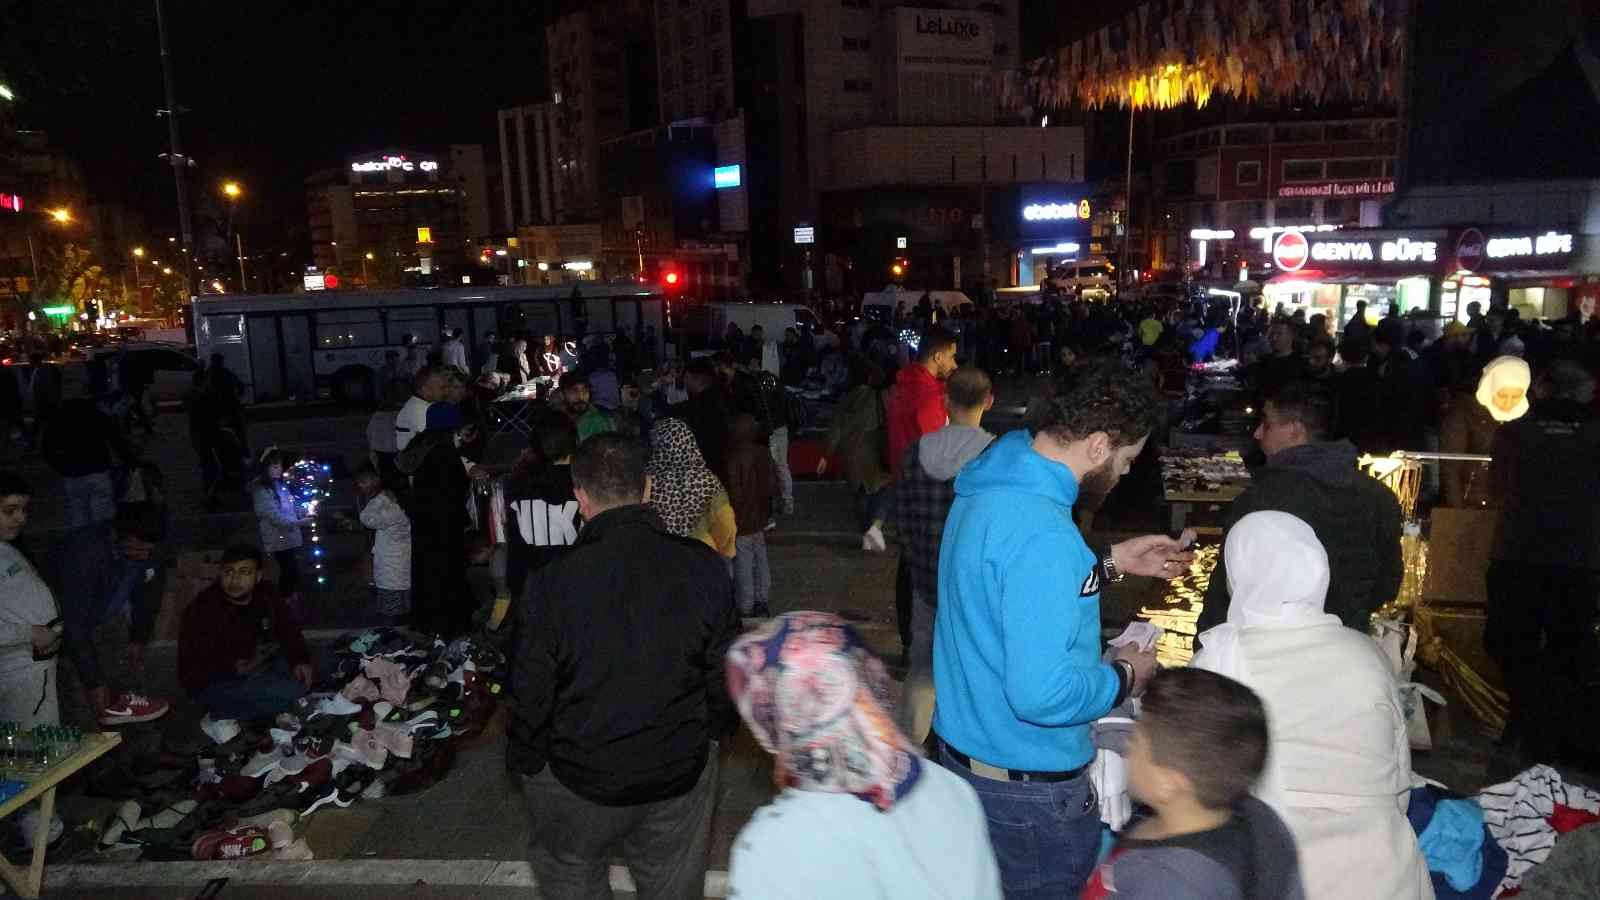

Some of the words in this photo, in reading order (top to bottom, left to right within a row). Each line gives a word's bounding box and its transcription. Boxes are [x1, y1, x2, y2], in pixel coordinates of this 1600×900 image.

[916, 15, 979, 37] LeLuxe
[1311, 242, 1373, 260] GENYA
[1381, 237, 1437, 261] BÜFE
